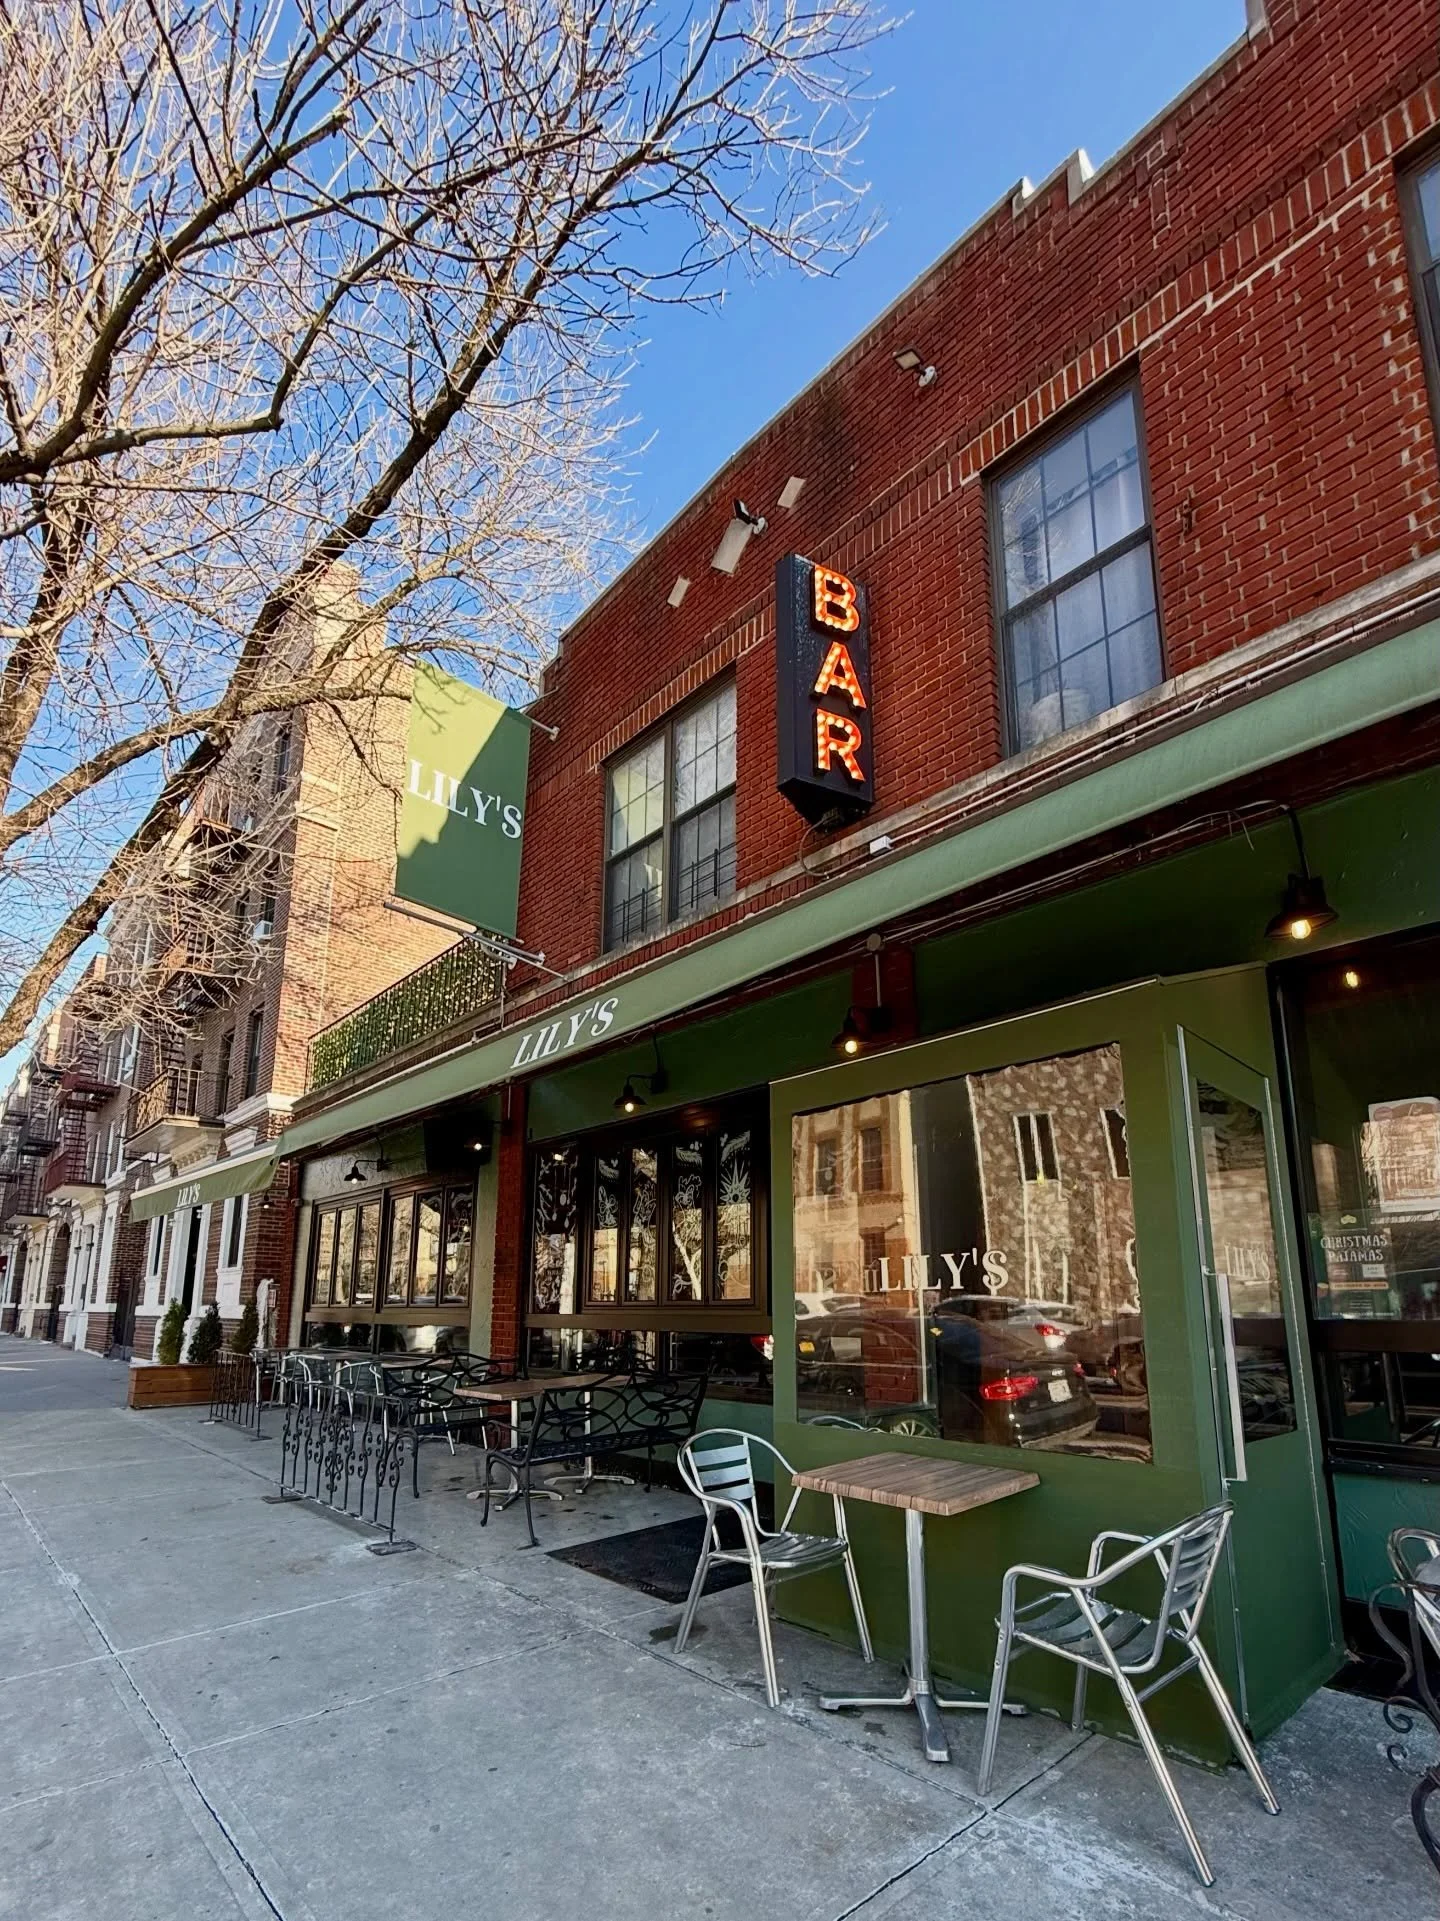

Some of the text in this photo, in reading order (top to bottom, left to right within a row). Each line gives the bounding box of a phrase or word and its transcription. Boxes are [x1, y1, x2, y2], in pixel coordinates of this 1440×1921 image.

[814, 564, 867, 781] BAR
[406, 759, 522, 840] LILY'S
[510, 997, 619, 1069] LILY'S
[1224, 1244, 1271, 1281] LILY'S
[1320, 1234, 1388, 1250] CHRISTMAS
[1328, 1248, 1385, 1262] PAJAMAS
[878, 1247, 1009, 1292] LILY'S
